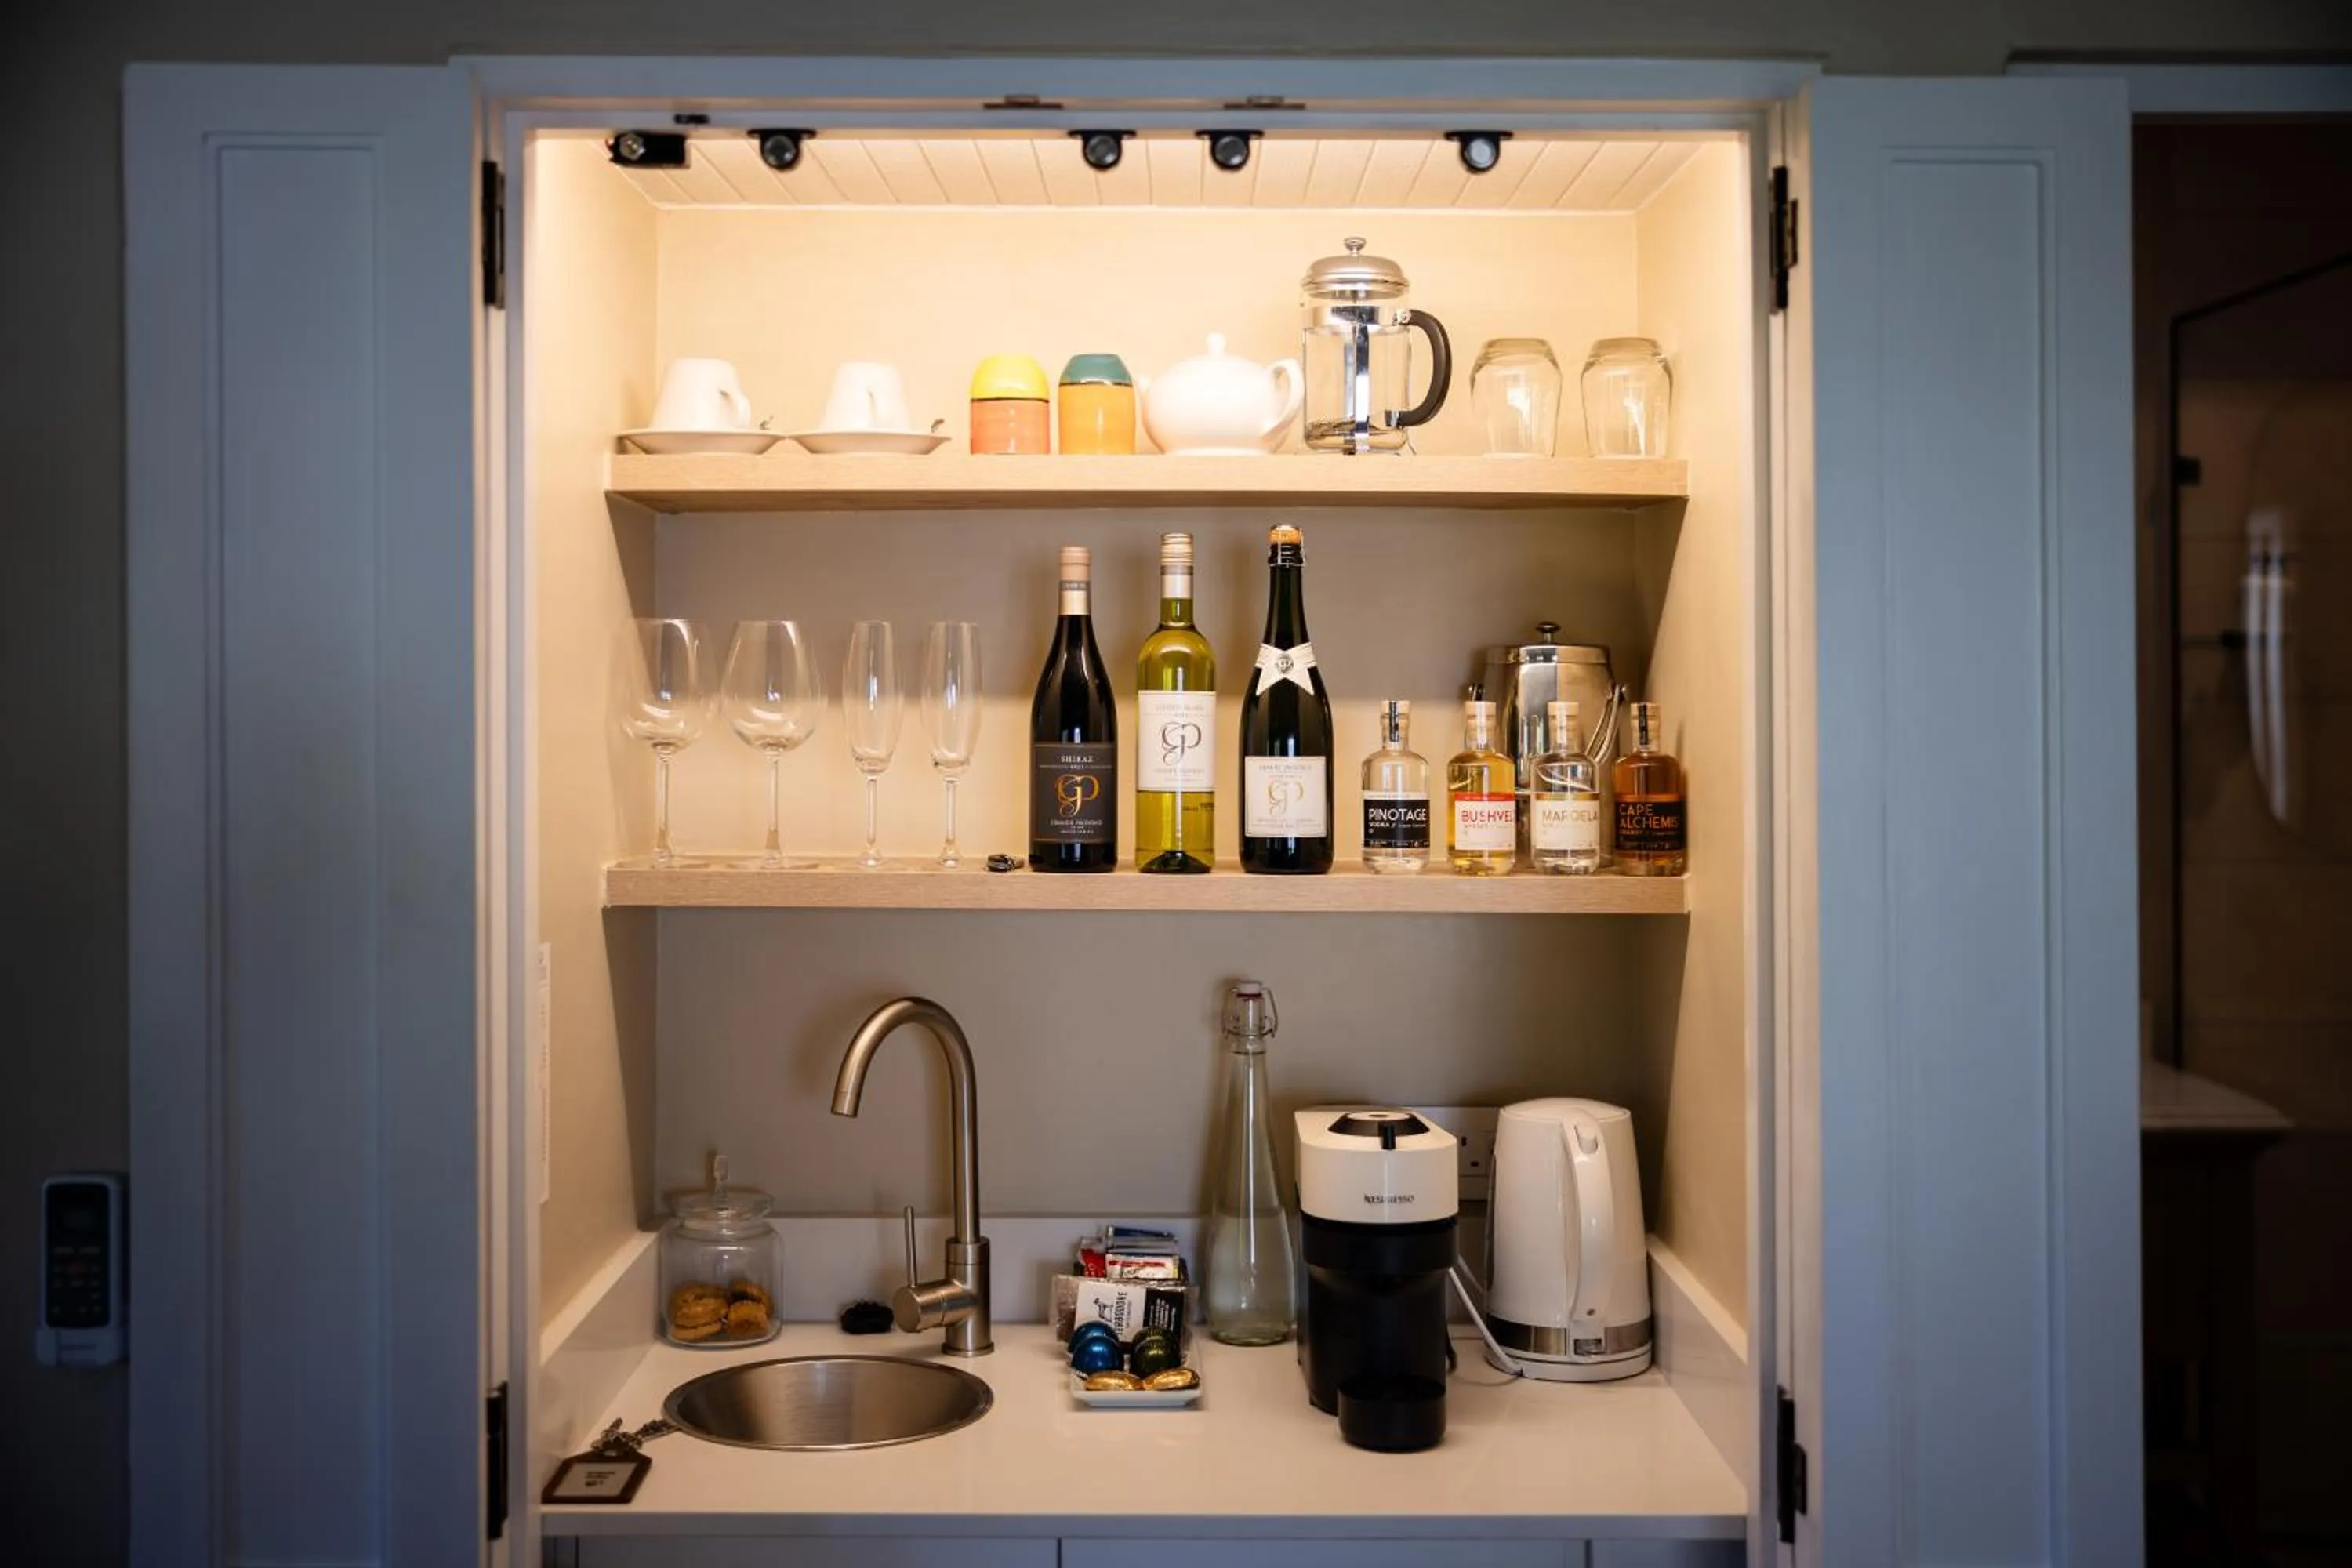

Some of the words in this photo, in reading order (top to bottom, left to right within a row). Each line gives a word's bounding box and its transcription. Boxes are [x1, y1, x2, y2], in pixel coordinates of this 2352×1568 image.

[1060, 755, 1094, 764] SHIRAZ
[1368, 808, 1427, 821] PINOTAGE
[1619, 804, 1653, 816] CAPE
